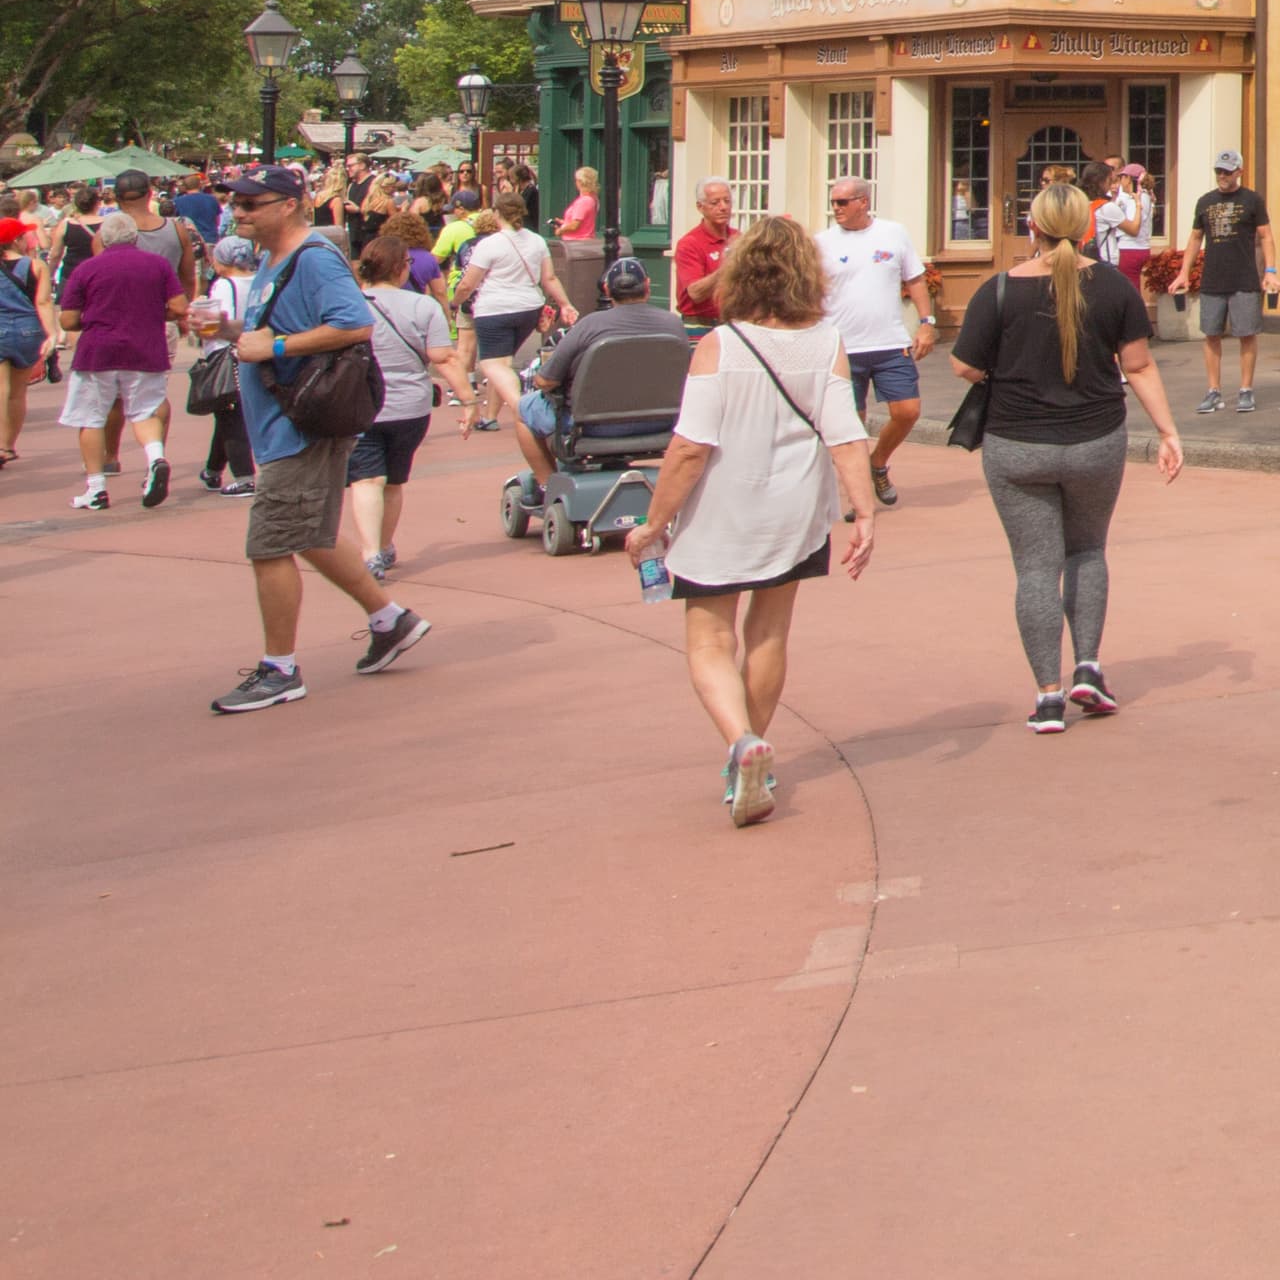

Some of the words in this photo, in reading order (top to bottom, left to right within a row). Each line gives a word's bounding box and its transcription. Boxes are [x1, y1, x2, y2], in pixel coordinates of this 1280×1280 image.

[816, 45, 849, 66] Stout
[911, 33, 944, 62] Fully
[945, 31, 997, 57] Licensed
[1049, 31, 1105, 60] Fully
[1109, 32, 1191, 57] Licensed
[720, 49, 738, 73] Ale
